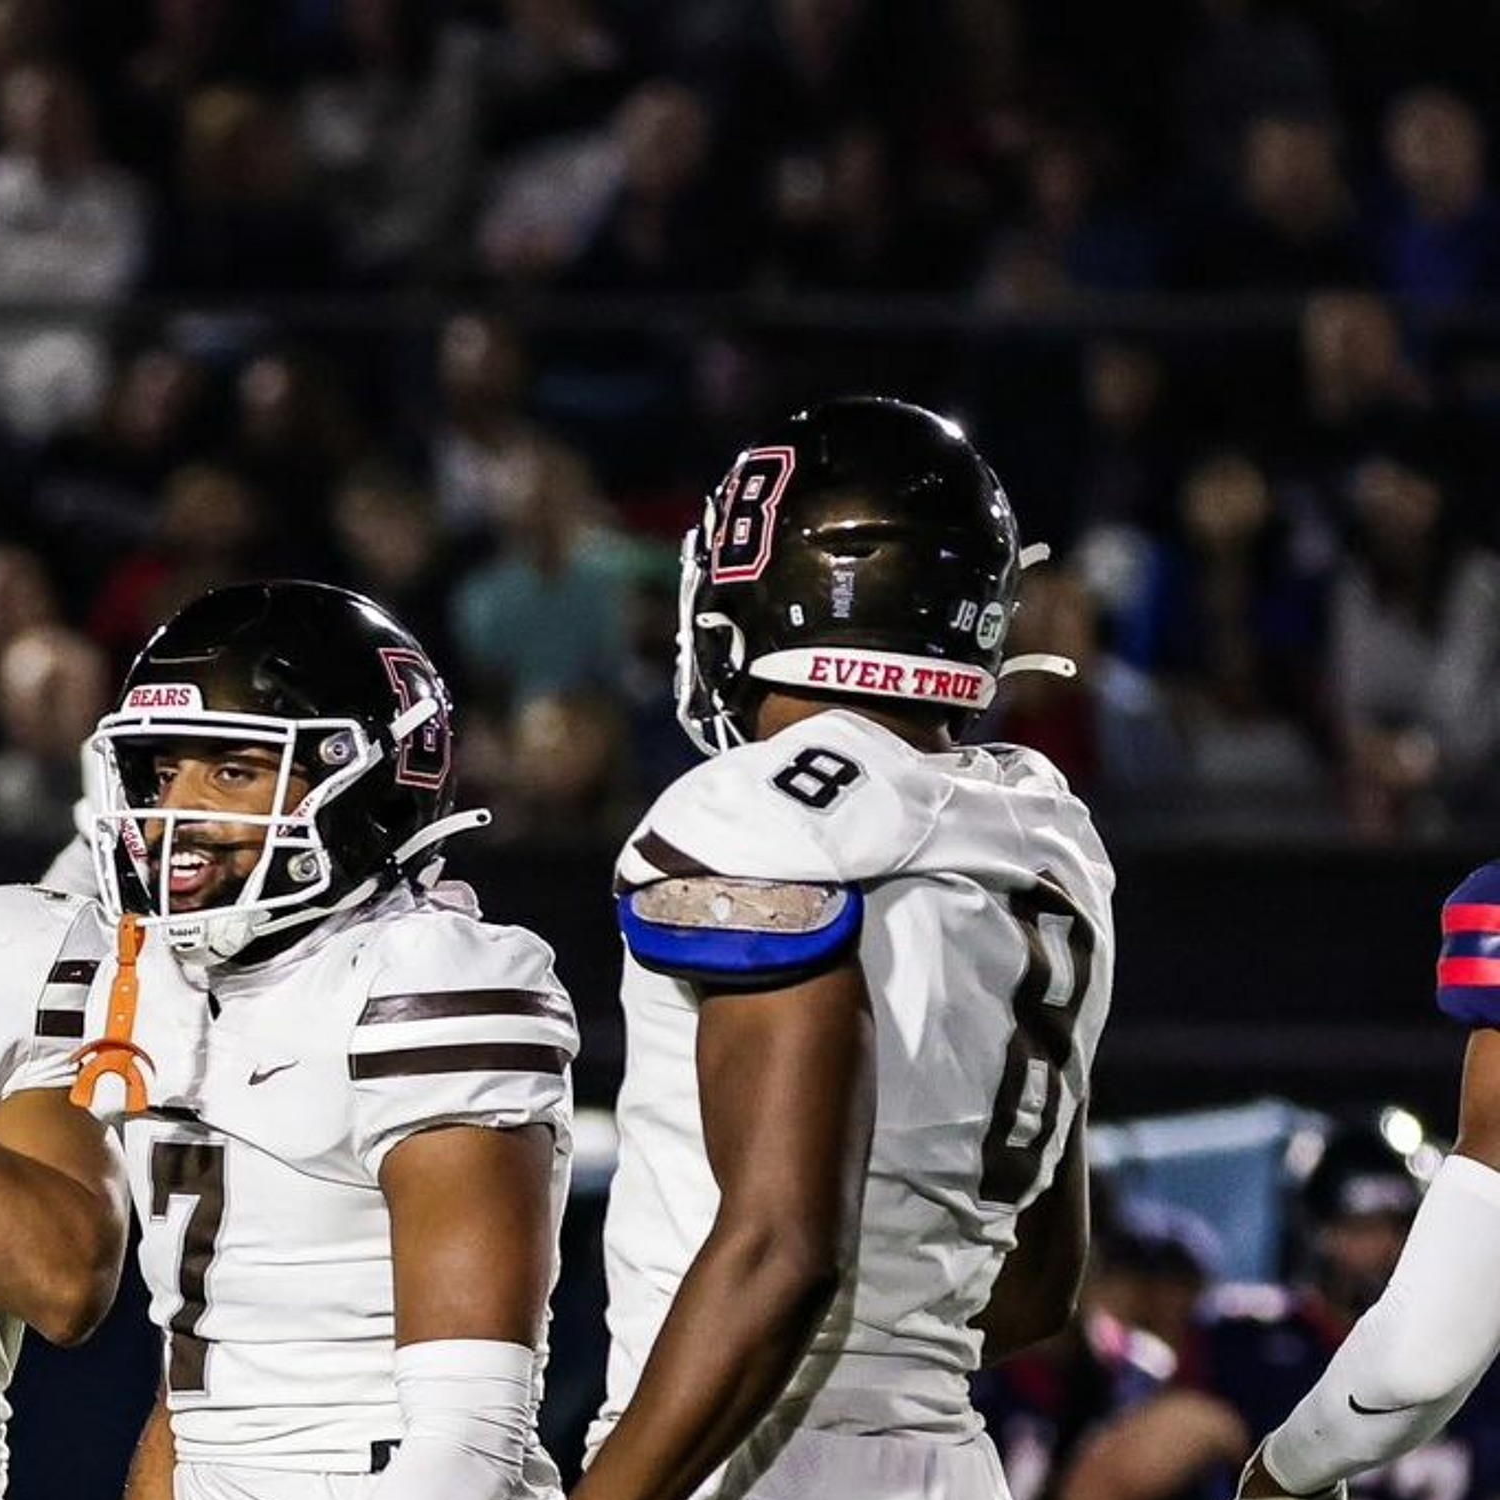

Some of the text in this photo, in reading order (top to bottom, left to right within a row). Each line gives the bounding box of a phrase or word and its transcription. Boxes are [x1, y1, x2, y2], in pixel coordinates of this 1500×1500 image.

[711, 446, 796, 584] B
[129, 688, 192, 707] BEARS
[377, 648, 451, 789] B
[808, 656, 982, 701] EVER TRUE
[770, 746, 866, 813] 8
[978, 868, 1096, 1208] 8
[148, 1138, 229, 1398] 7
